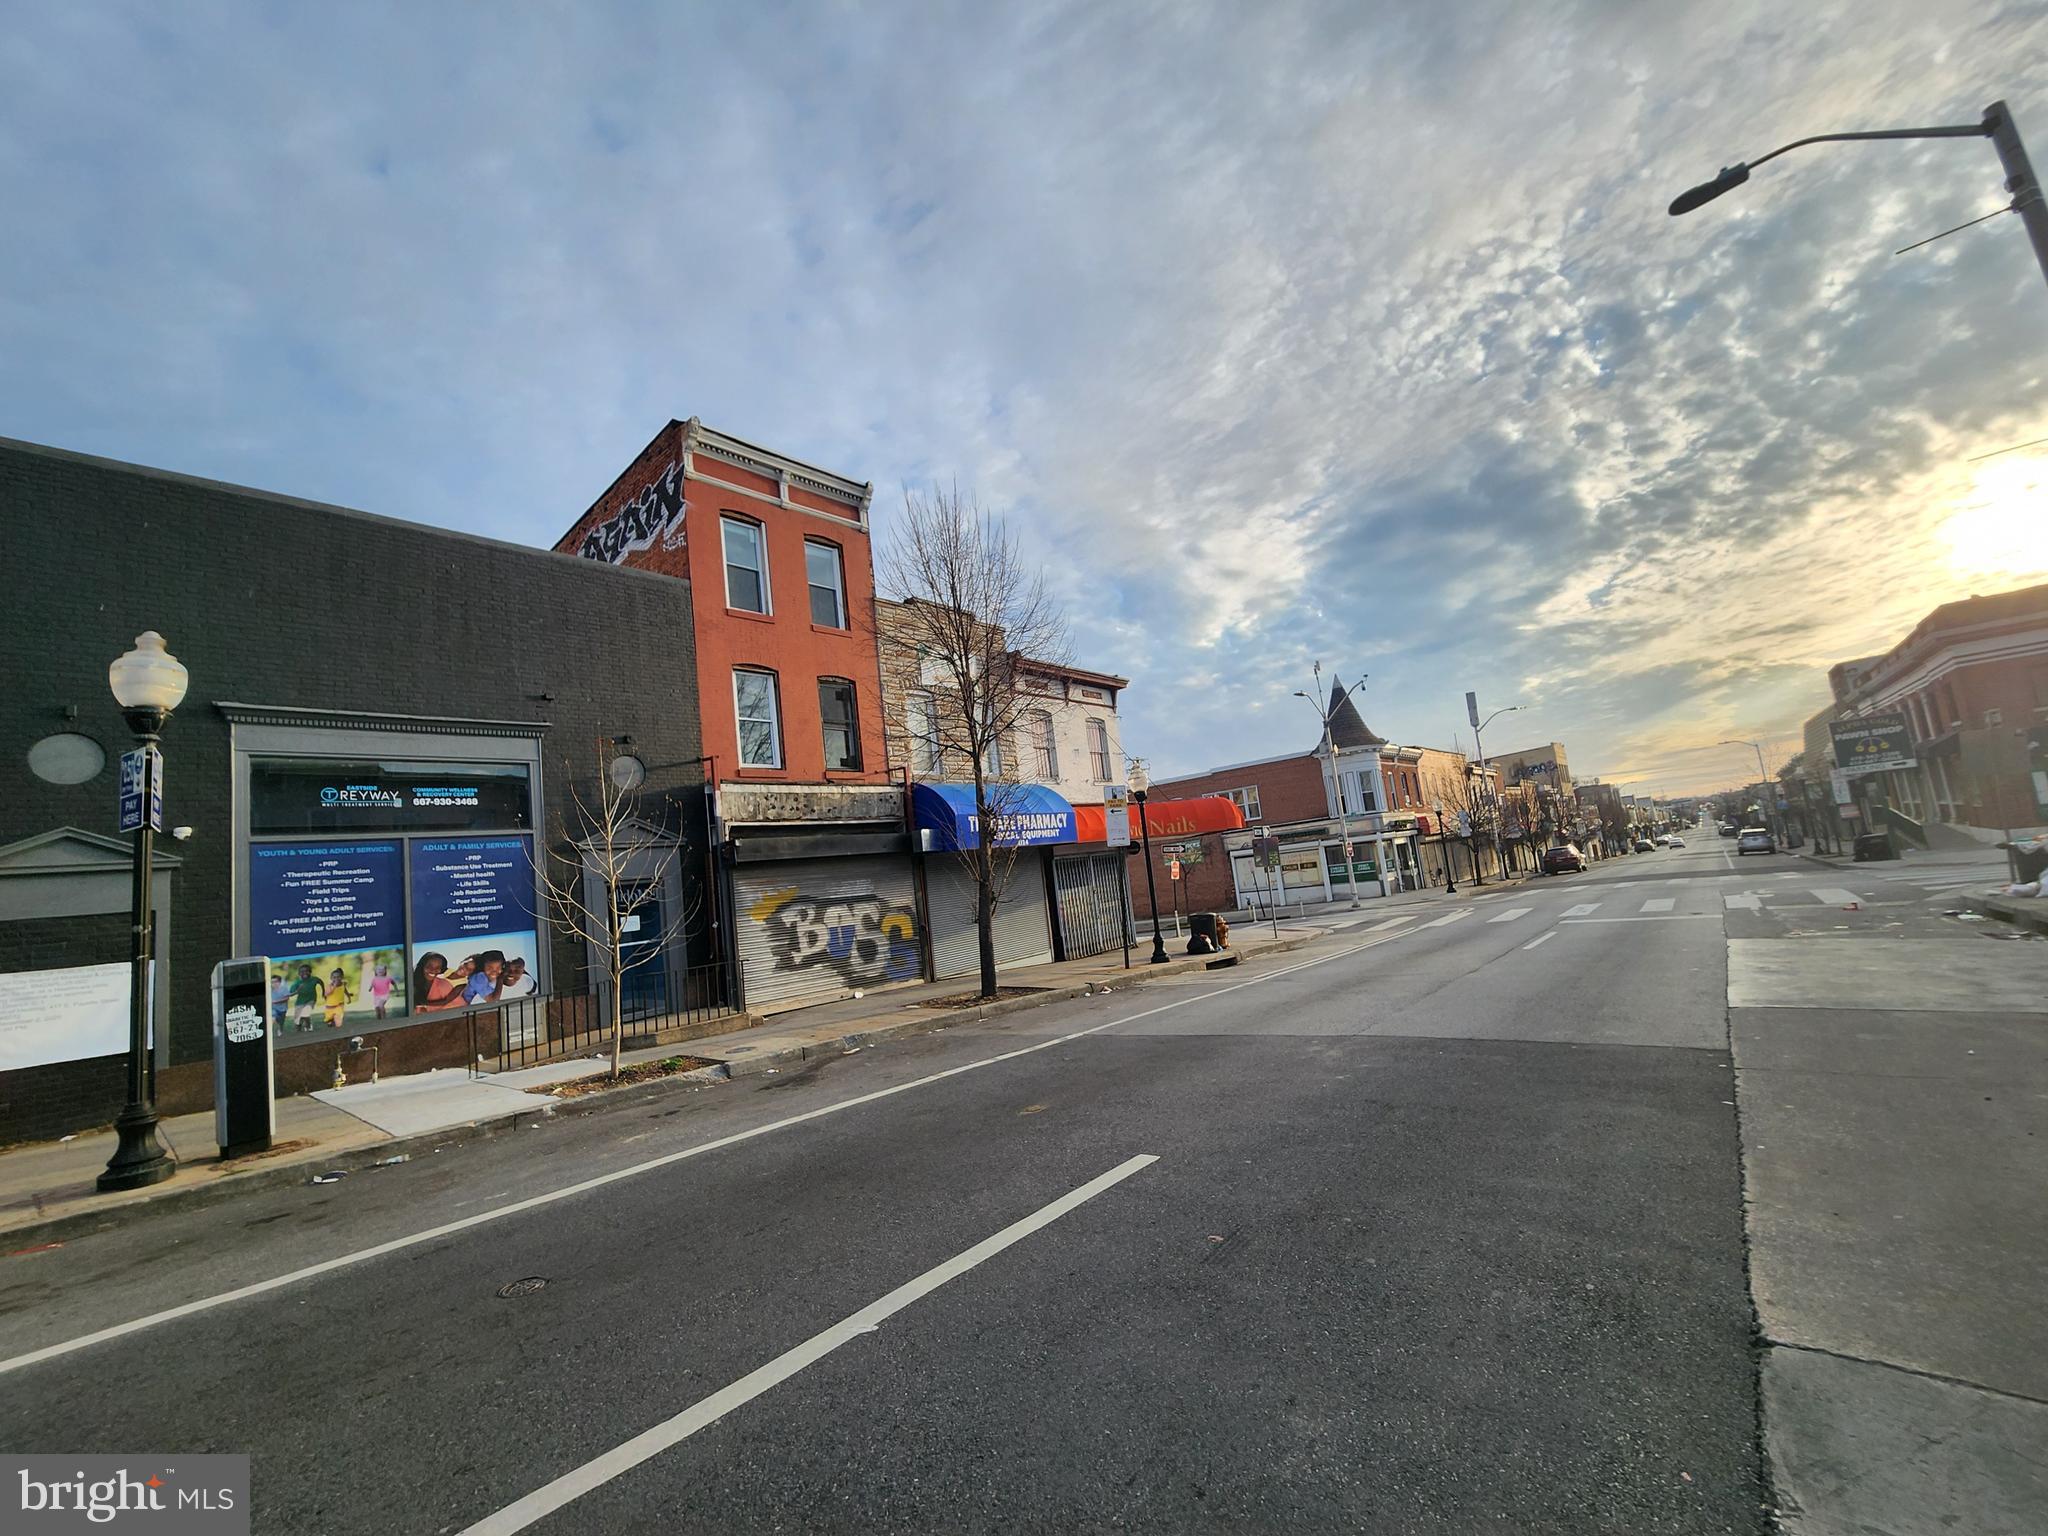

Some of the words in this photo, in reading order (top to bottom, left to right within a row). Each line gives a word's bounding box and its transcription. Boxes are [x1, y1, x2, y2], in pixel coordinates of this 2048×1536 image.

[1871, 725, 1904, 736] SHOP
[125, 799, 138, 812] PAY
[122, 811, 141, 826] HERE
[1017, 813, 1067, 830] PHARMACY
[1150, 816, 1196, 836] Nails
[1022, 829, 1060, 840] EQUIPMENT
[331, 887, 350, 895] Trips
[471, 896, 496, 905] Support
[464, 904, 504, 913] Management
[311, 914, 353, 922] Afterschool
[353, 911, 384, 920] Program
[281, 927, 312, 935] Therapy
[353, 920, 377, 928] Parent
[327, 935, 366, 946] Registered
